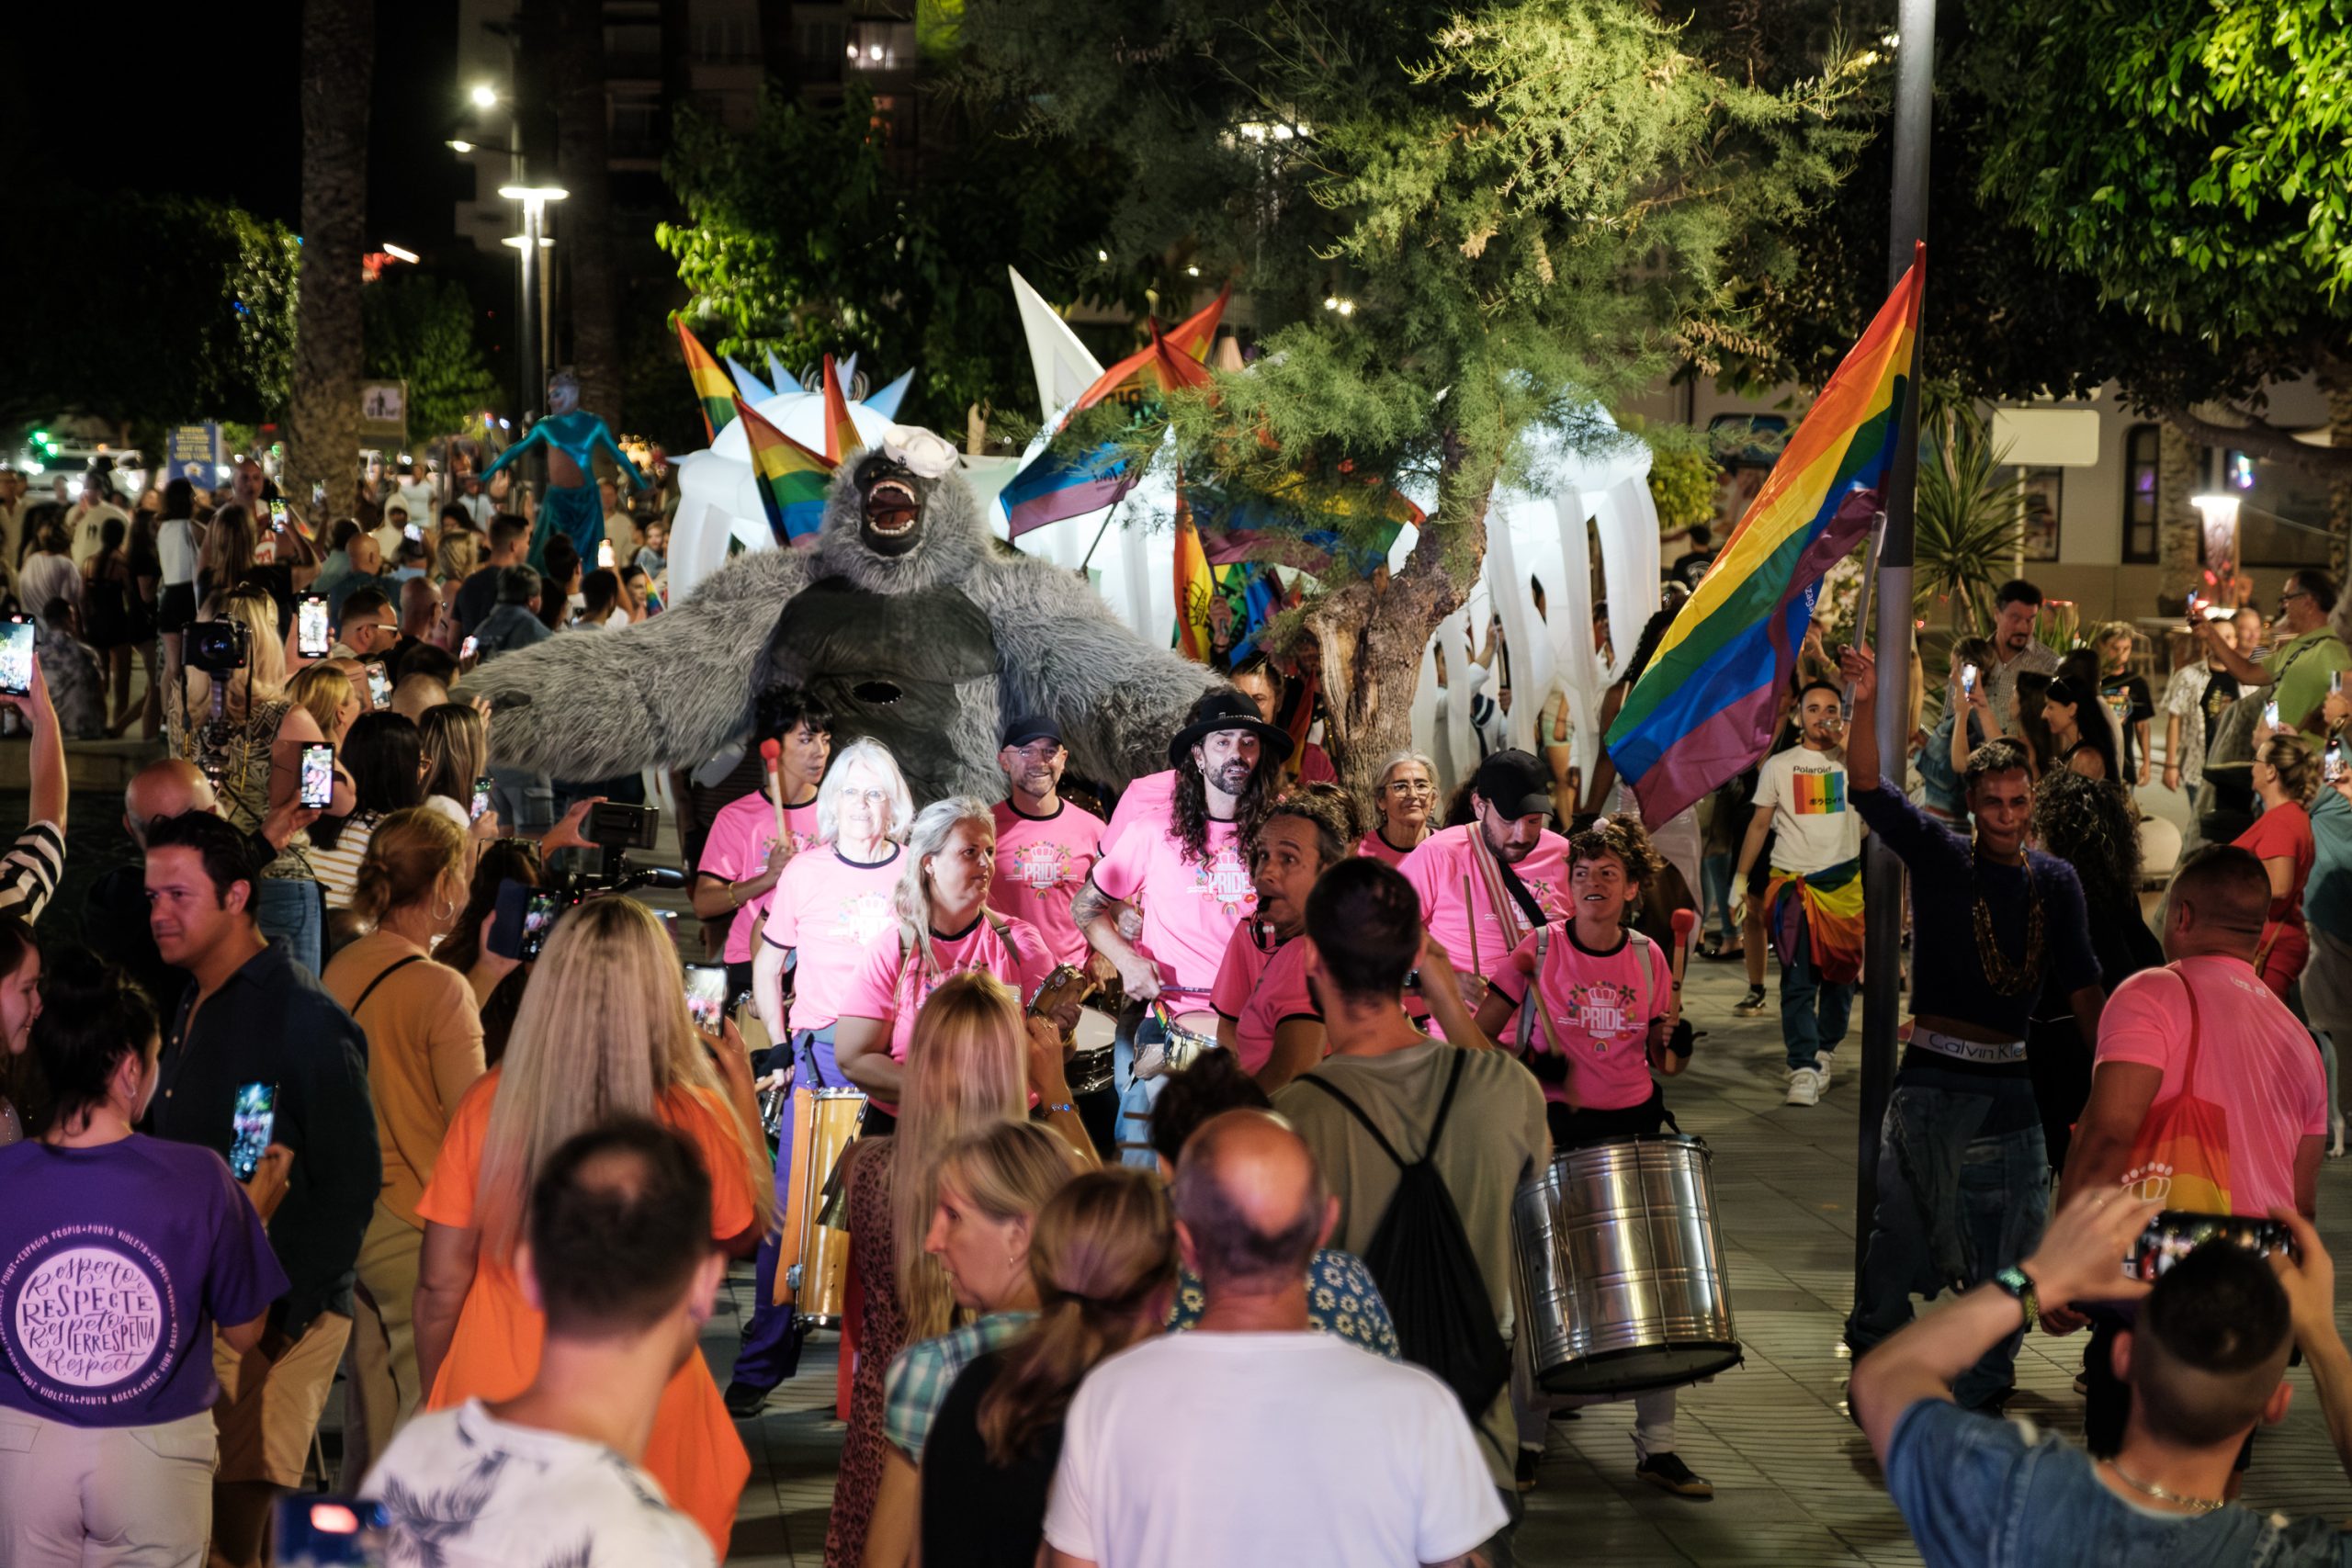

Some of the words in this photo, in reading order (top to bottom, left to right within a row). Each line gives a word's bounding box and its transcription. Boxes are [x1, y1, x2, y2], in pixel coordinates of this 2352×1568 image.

[1793, 765, 1831, 773] Polaroid
[1023, 863, 1062, 881] PRIDE
[1208, 872, 1251, 894] PRIDE
[1580, 1006, 1626, 1031] PRIDE
[1929, 1033, 1994, 1059] Calvin
[51, 1224, 81, 1240] PROPIO
[87, 1224, 114, 1236] PUNTO
[119, 1230, 148, 1255] VIOLETA
[24, 1310, 124, 1350] Respeto
[74, 1316, 154, 1358] ERRESPETUA
[36, 1350, 146, 1382] Respect
[40, 1386, 74, 1404] VIOLETA
[80, 1395, 107, 1405] PUNTU
